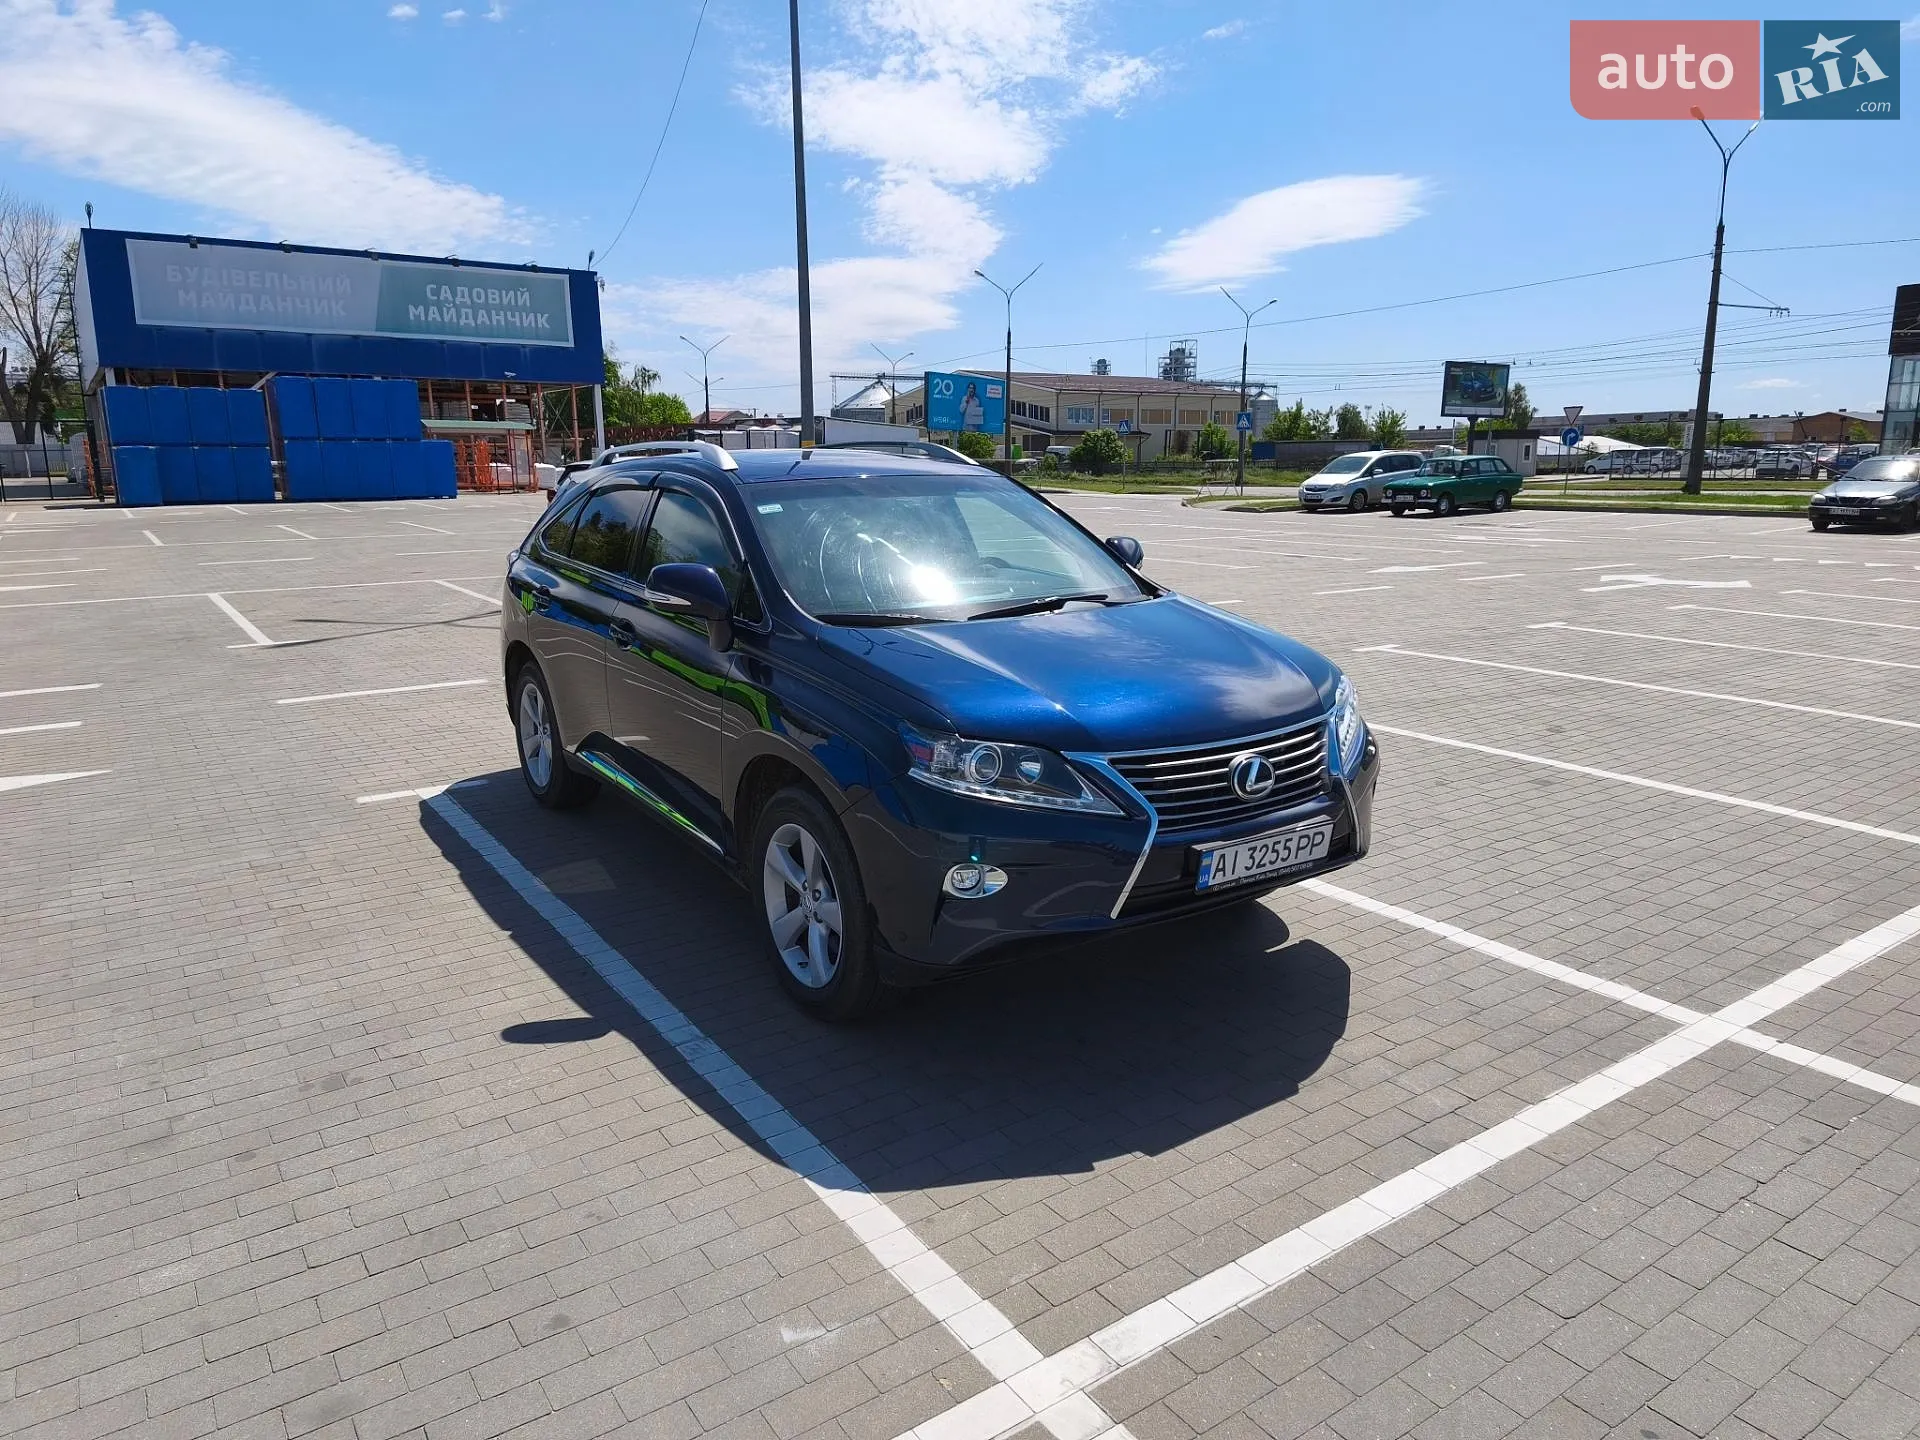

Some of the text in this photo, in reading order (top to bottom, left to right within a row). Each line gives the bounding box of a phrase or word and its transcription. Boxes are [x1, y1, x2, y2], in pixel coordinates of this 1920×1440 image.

[166, 264, 352, 296] БУДІВЕЛЬНИЙ
[177, 289, 347, 317] МАЙДАНЧИК
[426, 284, 531, 307] САДОВИЙ
[408, 303, 551, 329] МАЙДАНЧИК
[934, 378, 954, 395] 20
